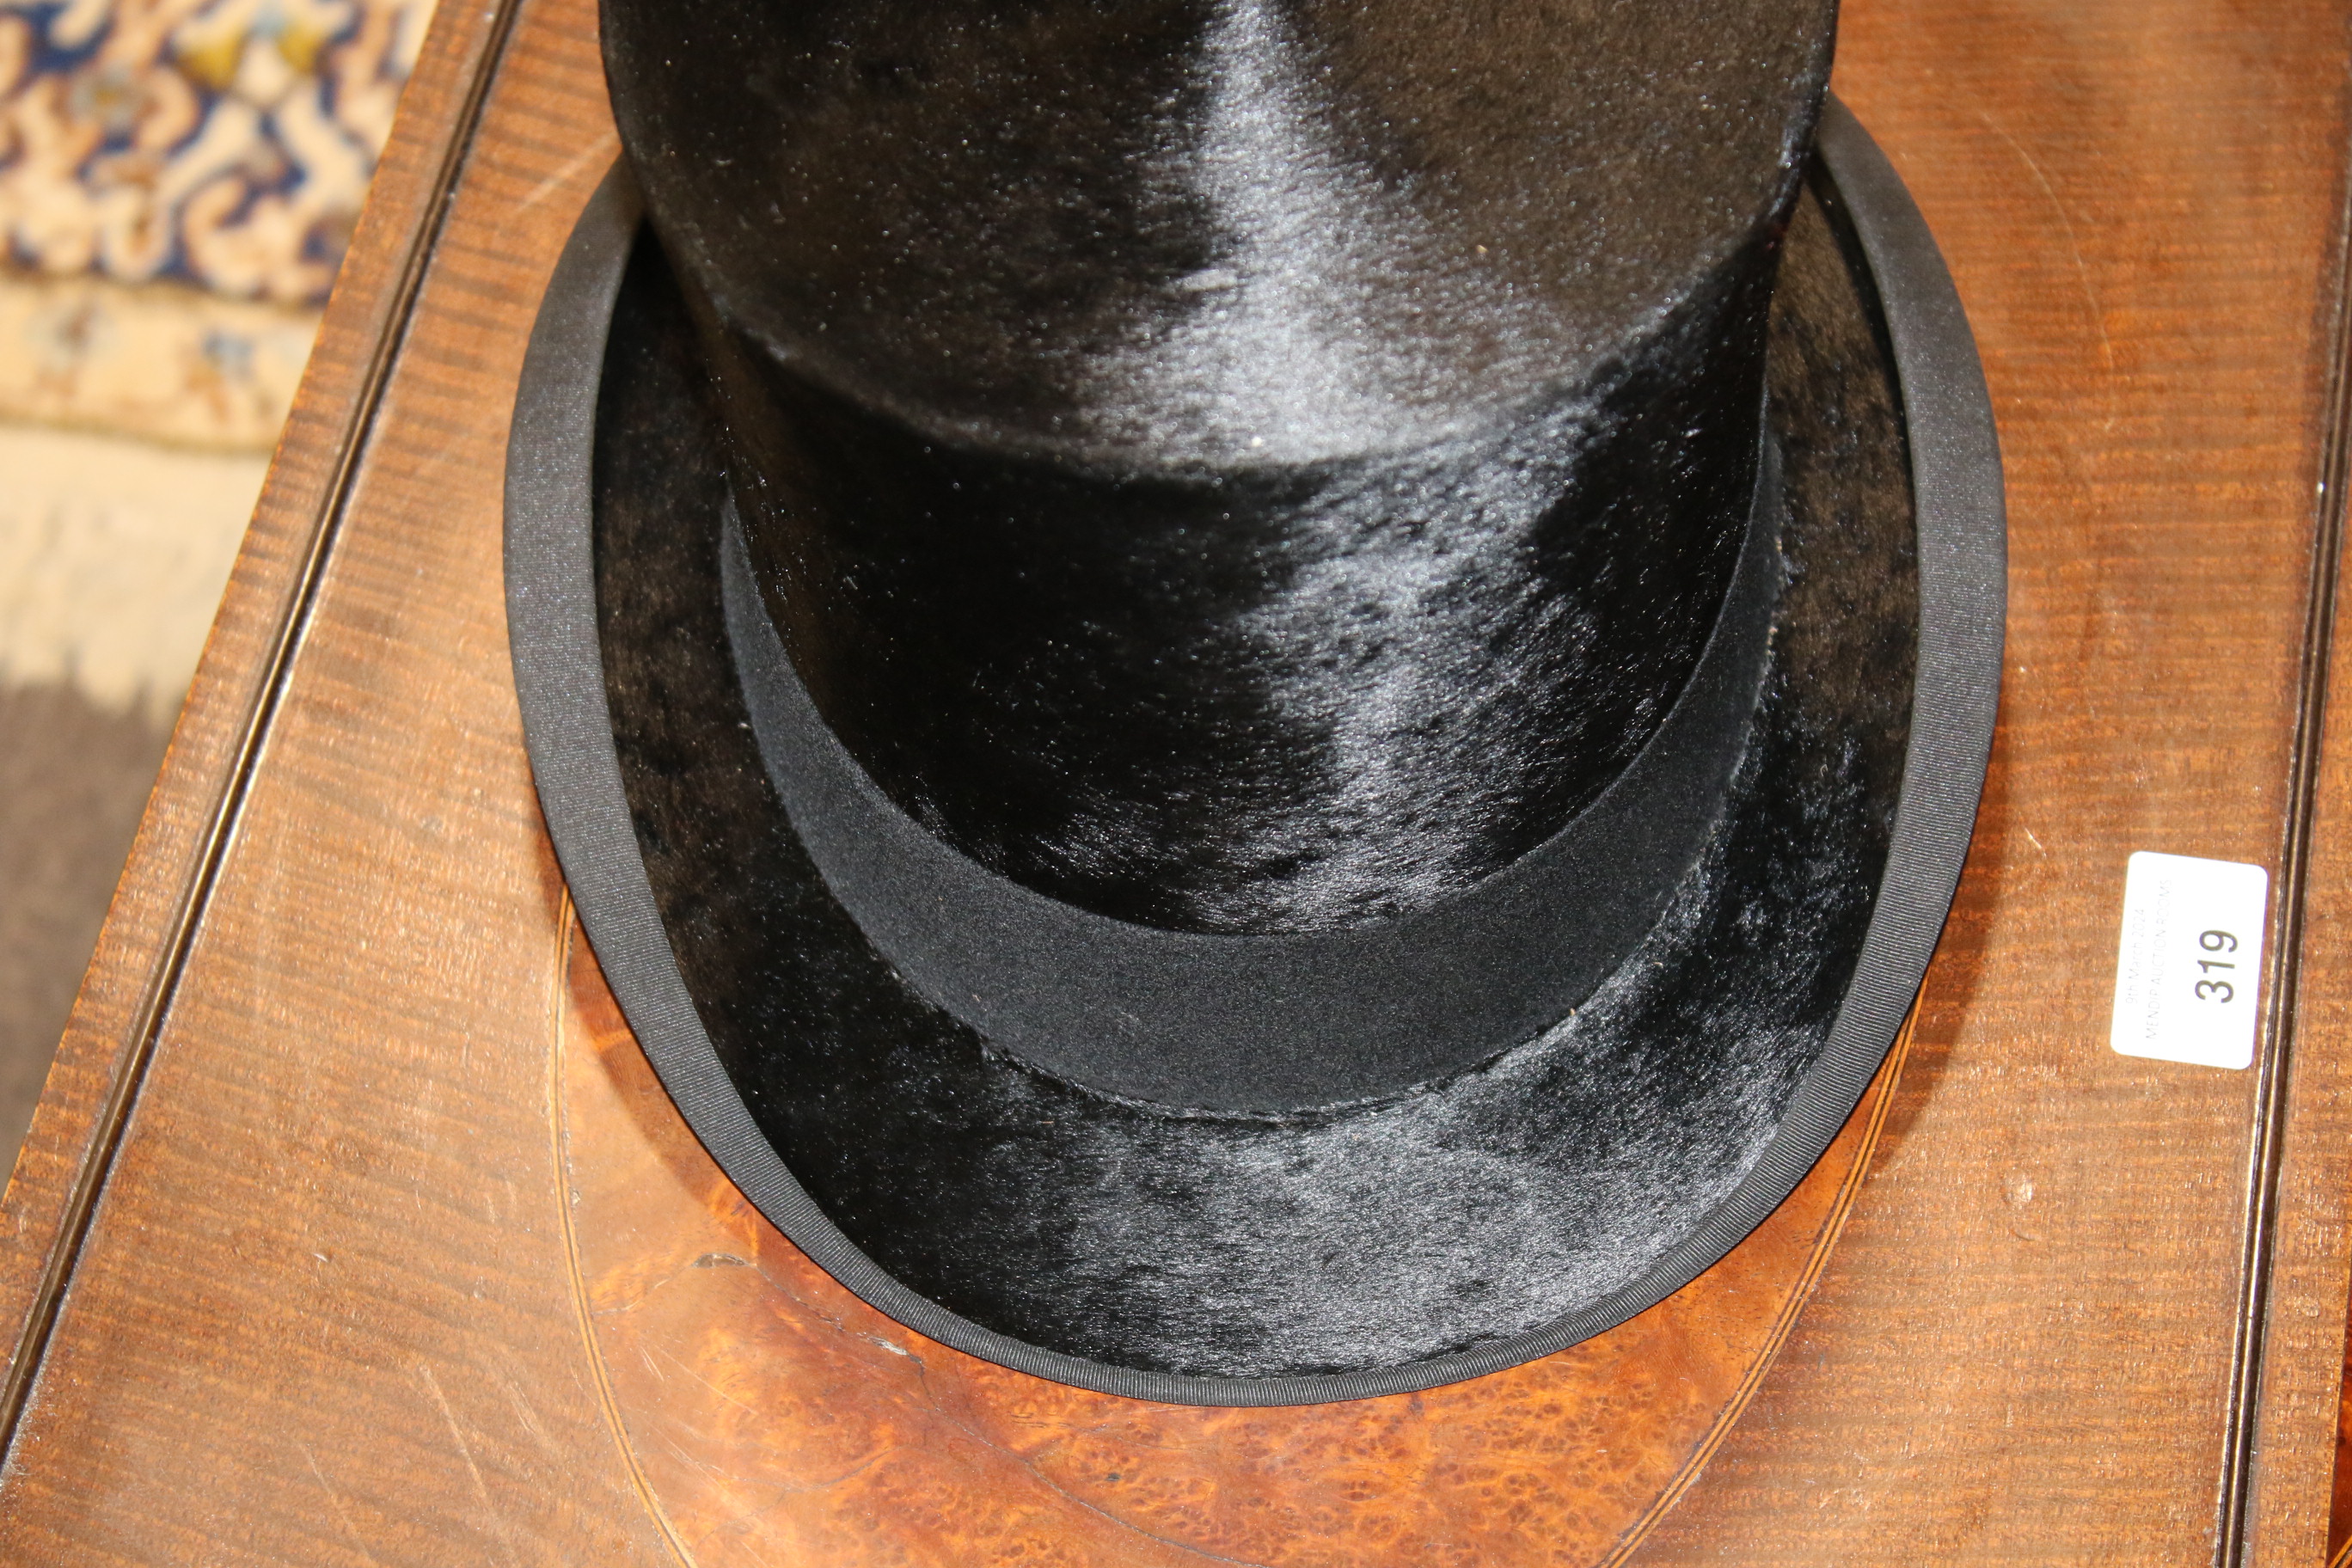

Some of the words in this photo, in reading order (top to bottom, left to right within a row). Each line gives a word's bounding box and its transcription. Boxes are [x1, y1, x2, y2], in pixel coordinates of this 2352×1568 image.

[2131, 909, 2146, 938] 2024
[2155, 879, 2171, 925] ROOMS
[2128, 942, 2143, 980] March
[2150, 929, 2167, 985] AUCTION
[2195, 929, 2239, 1004] 319
[2145, 989, 2160, 1040] MENDIP
